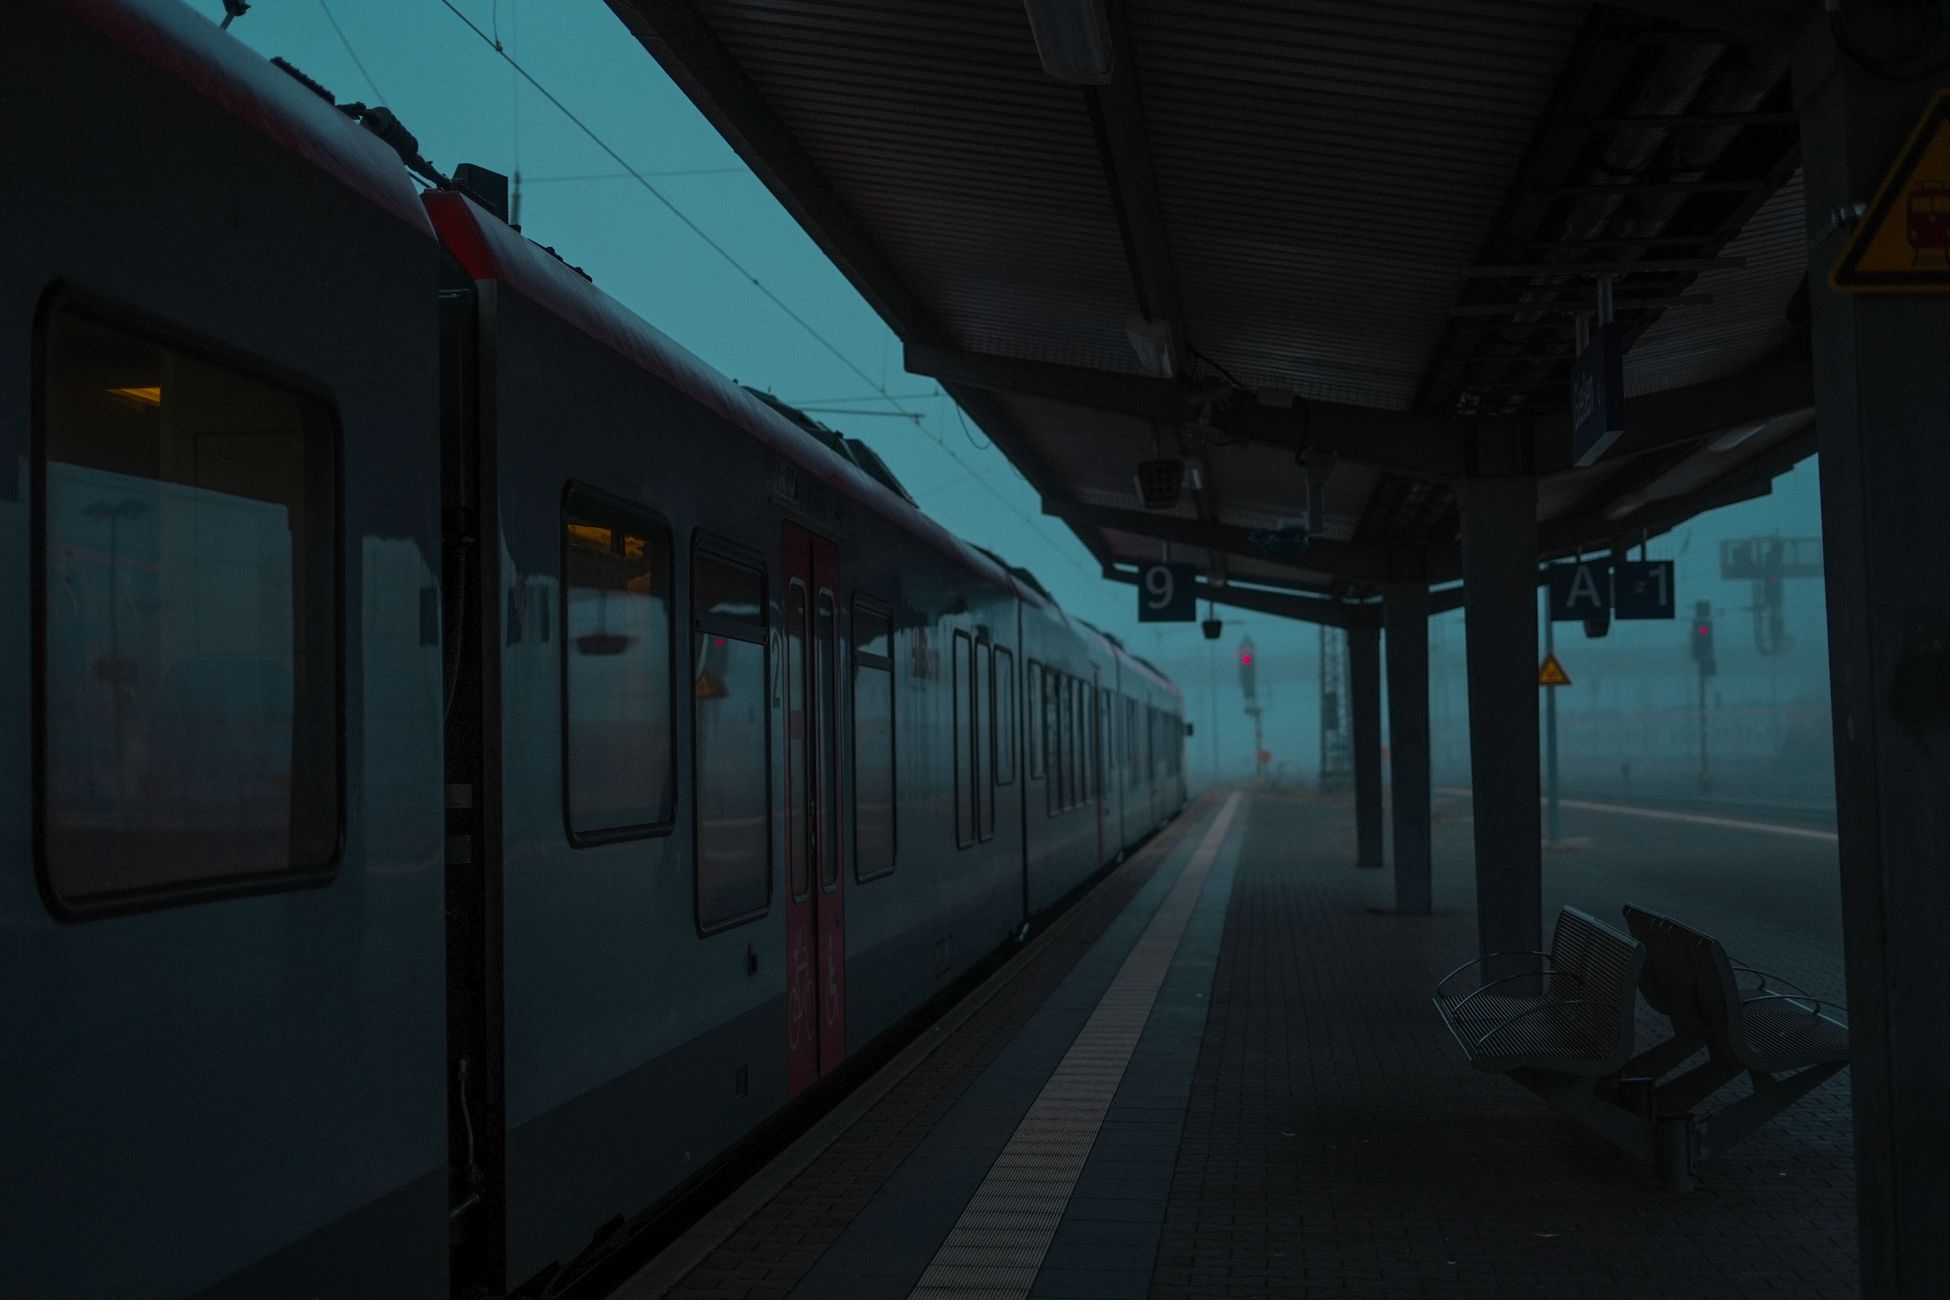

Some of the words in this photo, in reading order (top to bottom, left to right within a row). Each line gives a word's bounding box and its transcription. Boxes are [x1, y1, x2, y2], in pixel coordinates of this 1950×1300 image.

[1145, 565, 1175, 610] 9
[1565, 564, 1602, 608] A
[1647, 563, 1667, 607] 1
[771, 631, 781, 708] 2
